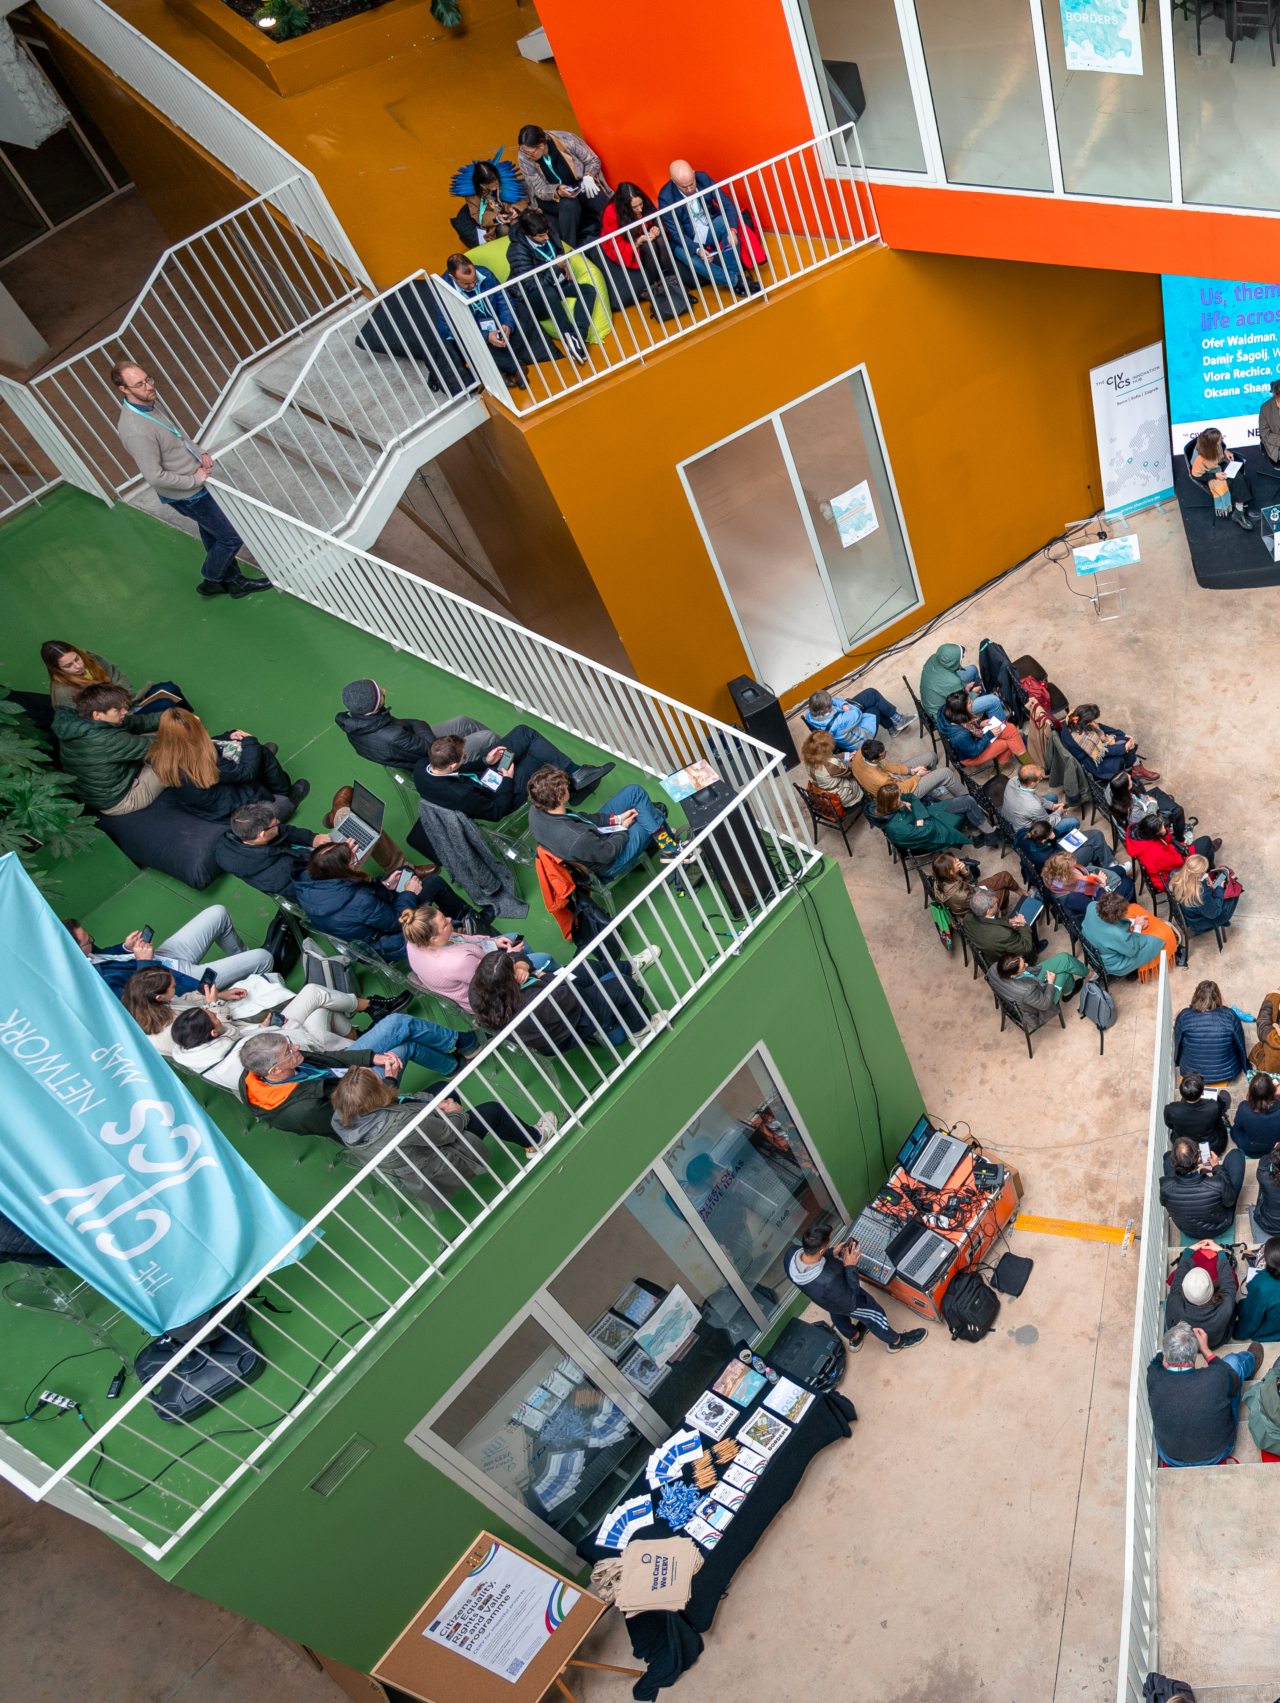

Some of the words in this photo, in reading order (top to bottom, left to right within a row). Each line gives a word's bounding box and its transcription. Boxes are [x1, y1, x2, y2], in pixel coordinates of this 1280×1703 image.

[1065, 12, 1119, 25] BORDERS
[1200, 287, 1227, 306] Us,
[1234, 283, 1280, 302] them
[1201, 311, 1231, 331] life
[1202, 338, 1225, 349] Ofer
[1227, 333, 1278, 347] Waldman,
[1202, 353, 1234, 366] Damir
[1236, 349, 1270, 363] Šagolj,
[1203, 371, 1231, 382] Vlora
[1233, 366, 1273, 379] Rechica,
[1204, 387, 1241, 398] Oksana
[0, 1008, 106, 1116] NETWORK
[90, 1042, 148, 1088] MAP
[724, 1159, 745, 1190] IDEAS
[128, 1260, 174, 1298] THE
[781, 1387, 800, 1413] OSLO
[714, 1410, 736, 1434] FUTURES!
[768, 1427, 789, 1451] BORDERS
[652, 1554, 662, 1577] Carry
[661, 1556, 669, 1576] CERV
[651, 1577, 659, 1591] You
[660, 1576, 667, 1589] We
[460, 1581, 497, 1621] Equality,
[468, 1615, 485, 1635] and
[483, 1583, 512, 1613] Values
[439, 1598, 473, 1637] Citizens
[452, 1613, 479, 1644] Rights
[465, 1595, 511, 1652] programme
